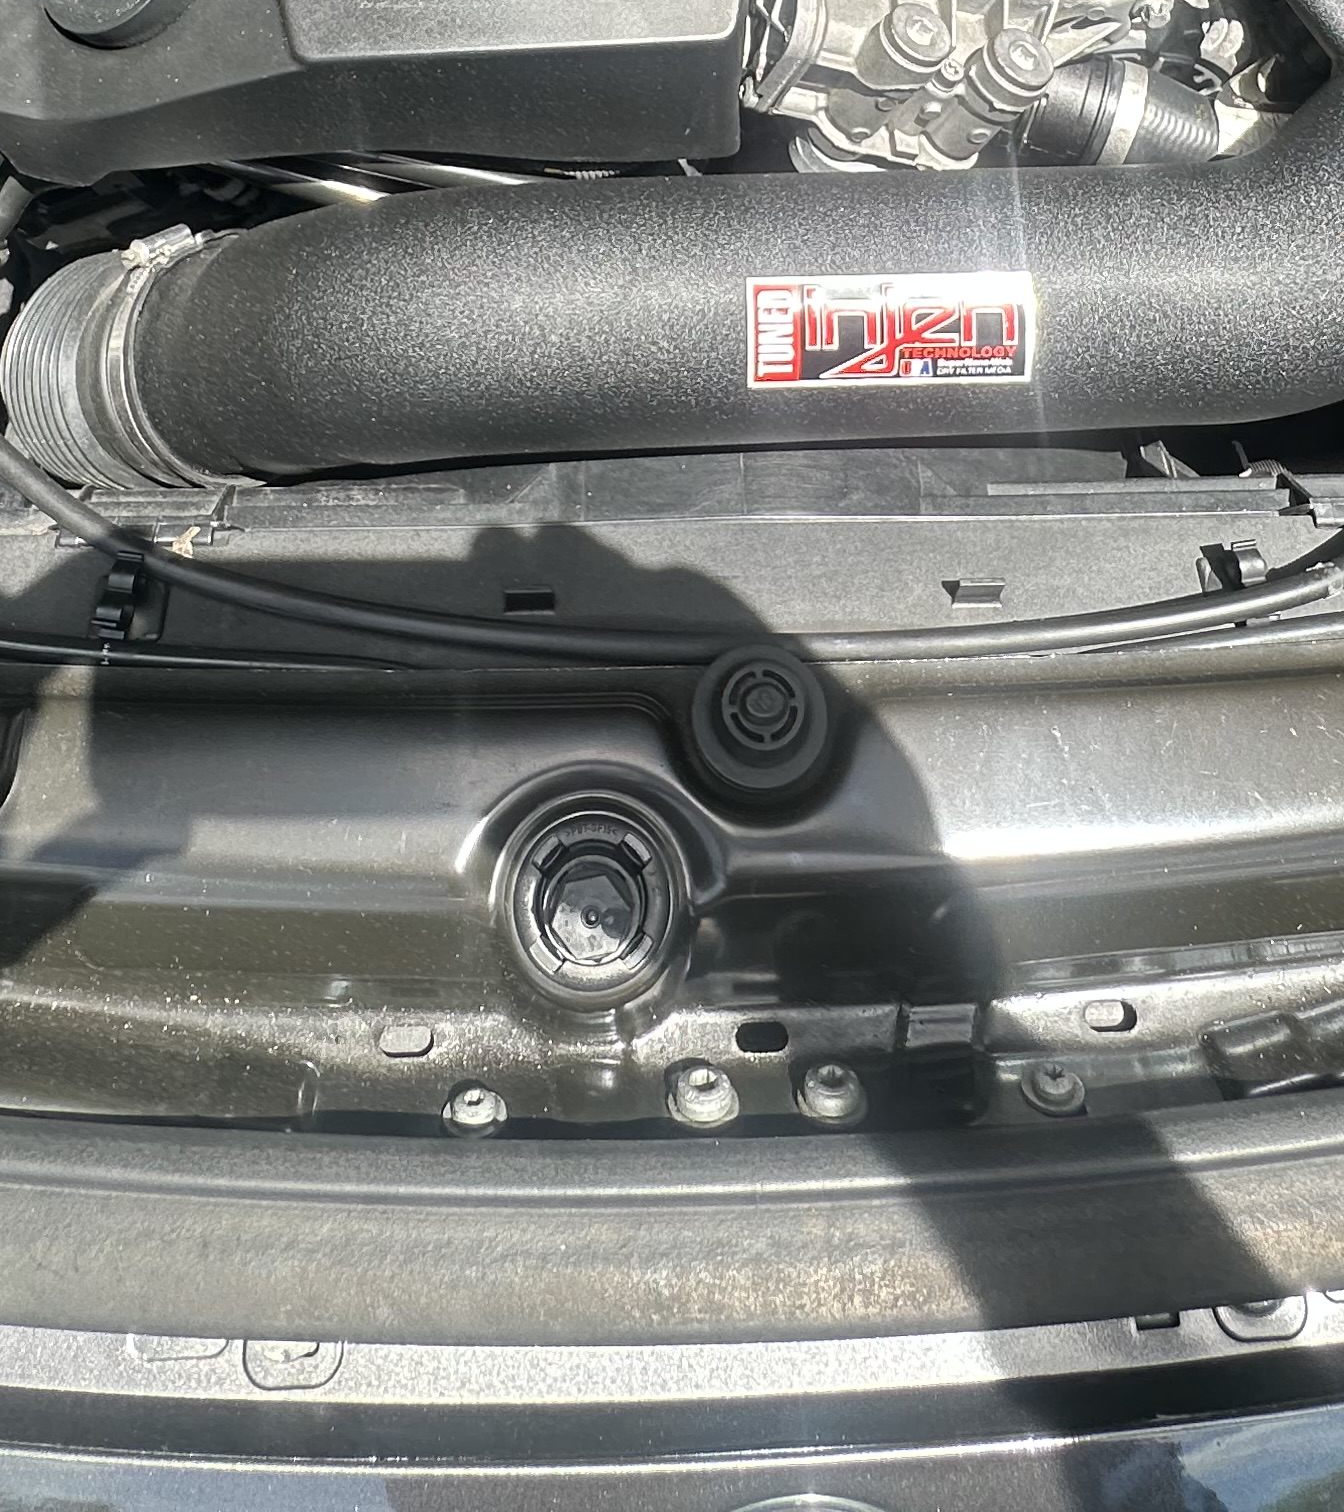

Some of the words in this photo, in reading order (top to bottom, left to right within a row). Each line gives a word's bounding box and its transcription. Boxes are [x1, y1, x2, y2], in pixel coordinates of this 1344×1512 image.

[758, 289, 794, 376] TUNED
[903, 346, 1017, 359] TECHNOLOGY
[902, 360, 931, 376] UA
